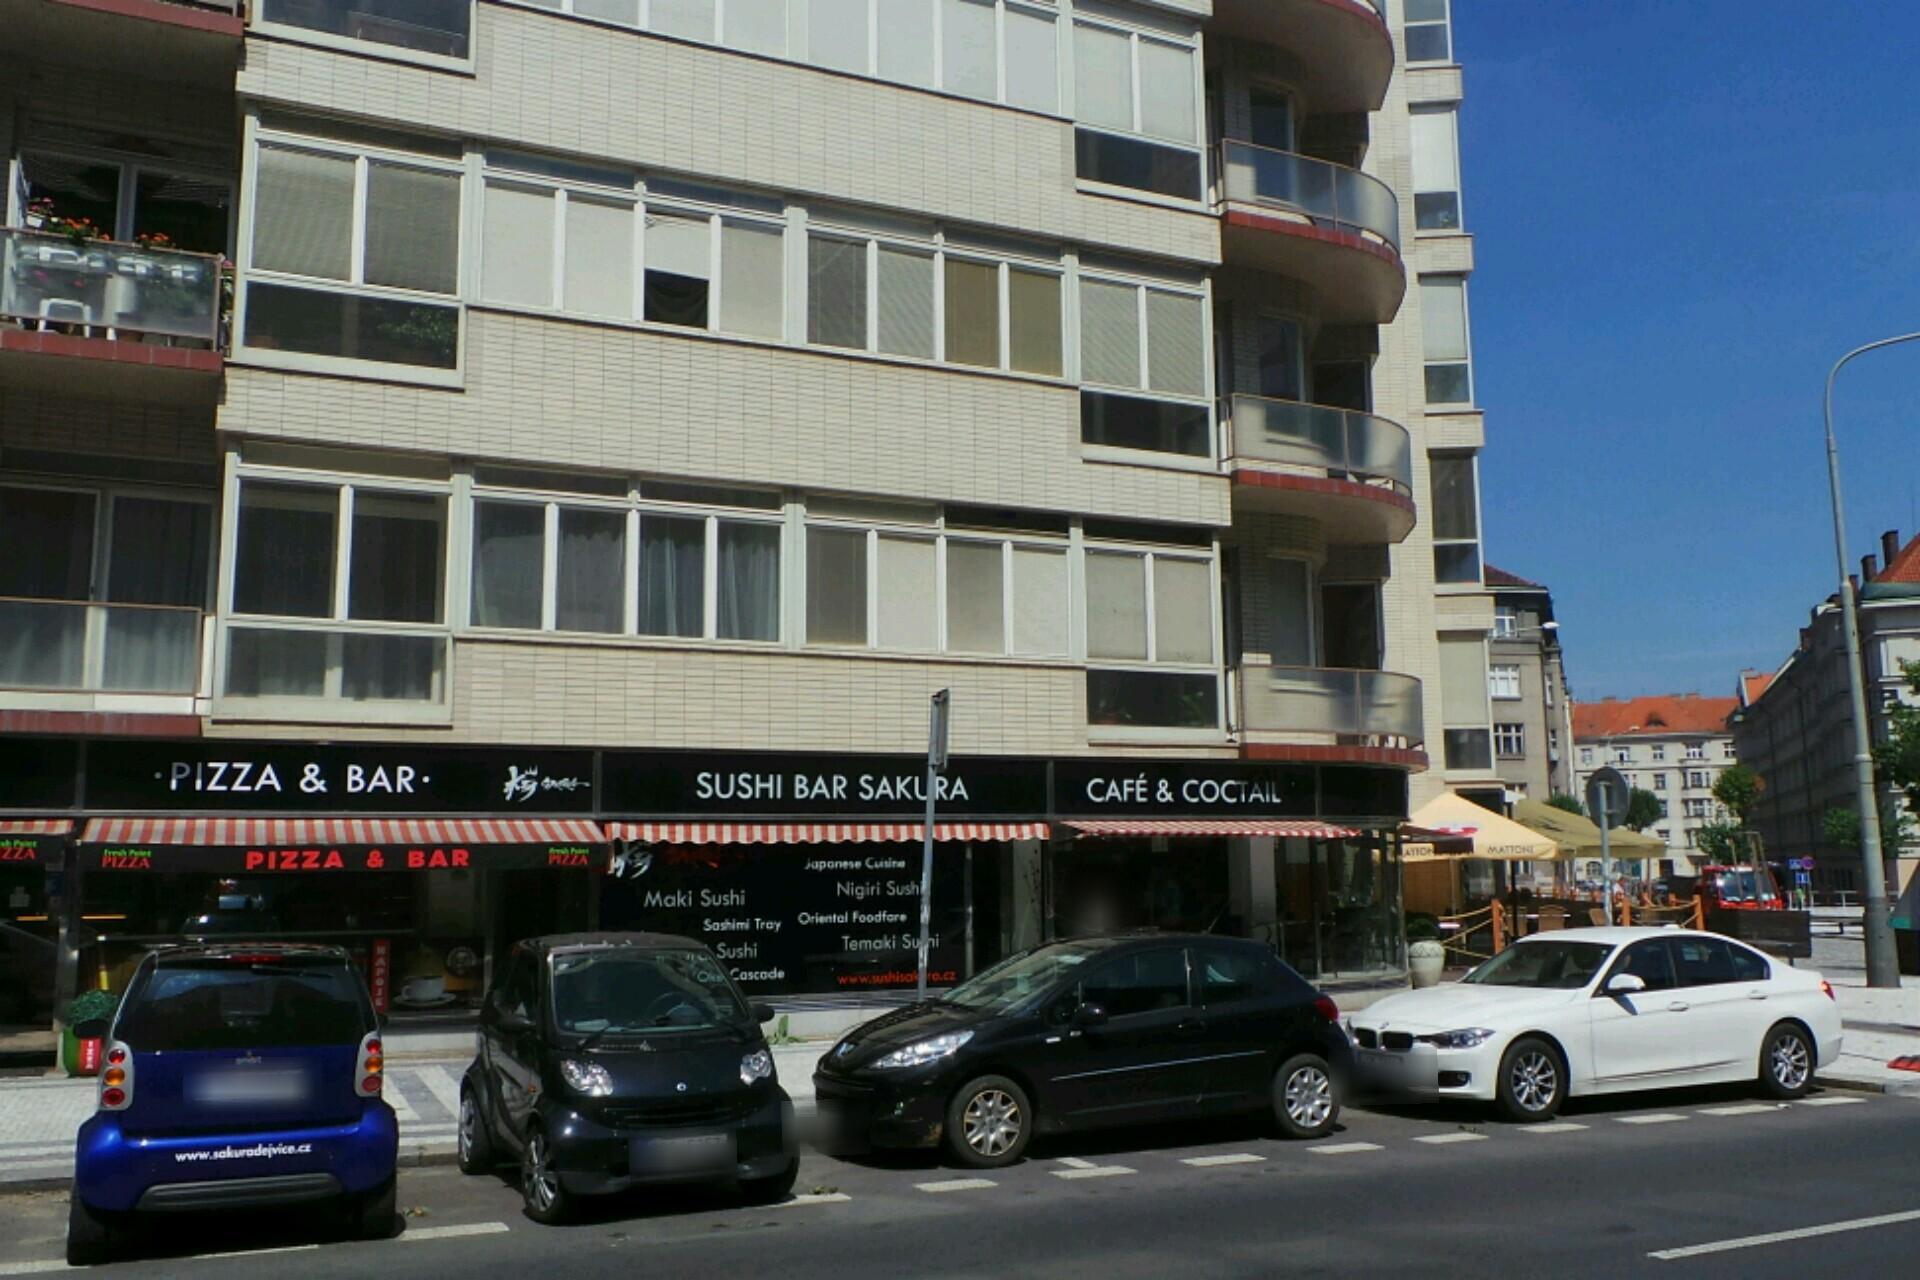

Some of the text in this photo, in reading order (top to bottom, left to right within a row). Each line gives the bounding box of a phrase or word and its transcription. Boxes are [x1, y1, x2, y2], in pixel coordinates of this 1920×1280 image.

[169, 761, 416, 793] PIZZA & BAR
[696, 772, 969, 801] SUSHI BAR SAKURA
[1086, 772, 1281, 804] CAFÉ & COCTAIL
[101, 856, 151, 869] PIZZA
[246, 848, 470, 870] PIZZA & BAR
[548, 854, 588, 865] PIZZA
[804, 857, 906, 872] Japanese Cuisine
[643, 888, 746, 907] Maki Sushi
[836, 881, 881, 900] Nigiri
[703, 918, 782, 933] Sashimi Tray
[798, 910, 908, 925] Oriental Foodfare
[716, 942, 758, 959] Sushi
[841, 935, 896, 951] Temaki
[730, 966, 786, 981] Cascade
[175, 1142, 313, 1162] www.sakuradejvice.cz
